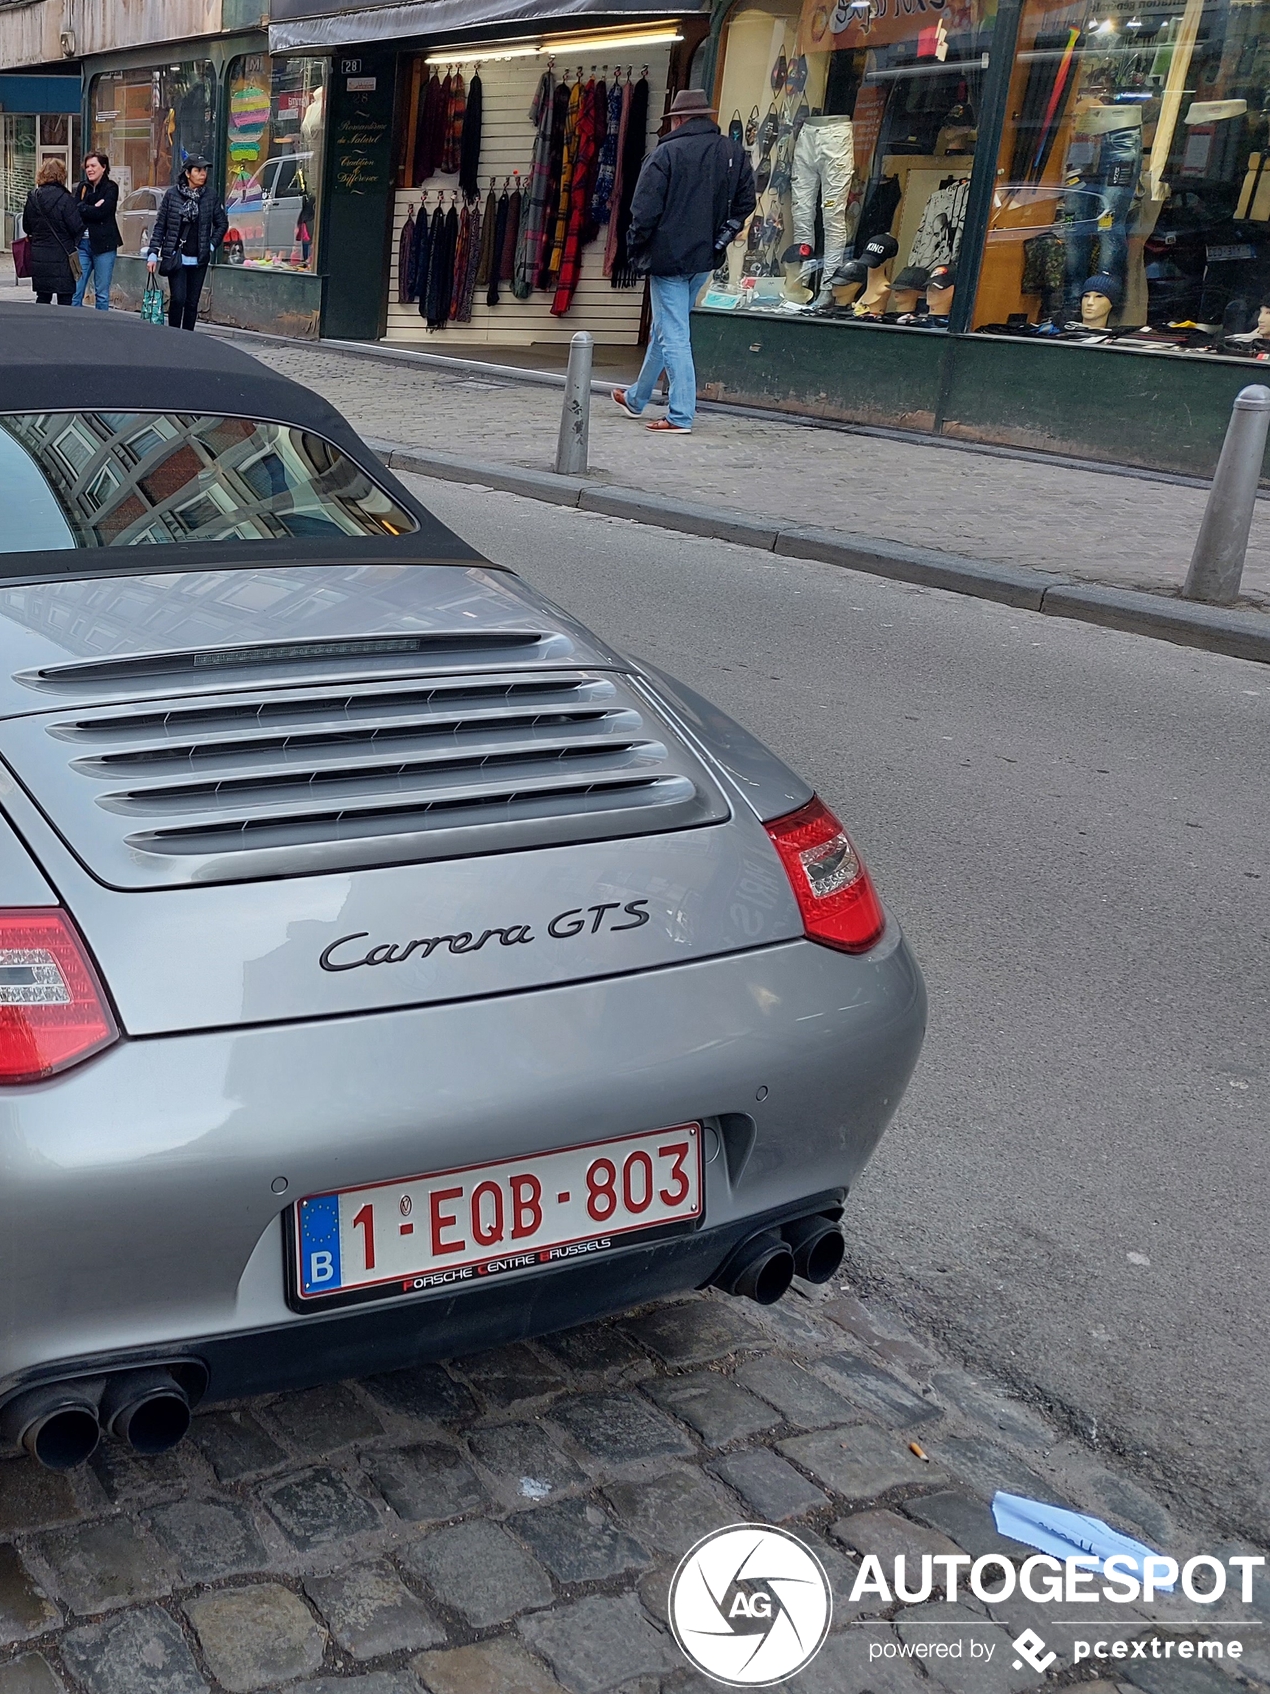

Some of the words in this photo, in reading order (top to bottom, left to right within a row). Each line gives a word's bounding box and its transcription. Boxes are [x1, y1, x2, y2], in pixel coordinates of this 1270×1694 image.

[345, 60, 357, 72] 28
[867, 242, 885, 254] KING
[319, 923, 536, 972] Carrera
[548, 899, 649, 939] GTS
[353, 1142, 690, 1270] 1-EQB-803
[311, 1250, 334, 1284] B
[403, 1266, 473, 1292] PORSCHE
[477, 1254, 535, 1275] CENTRE
[540, 1238, 611, 1262] BRUSSELS
